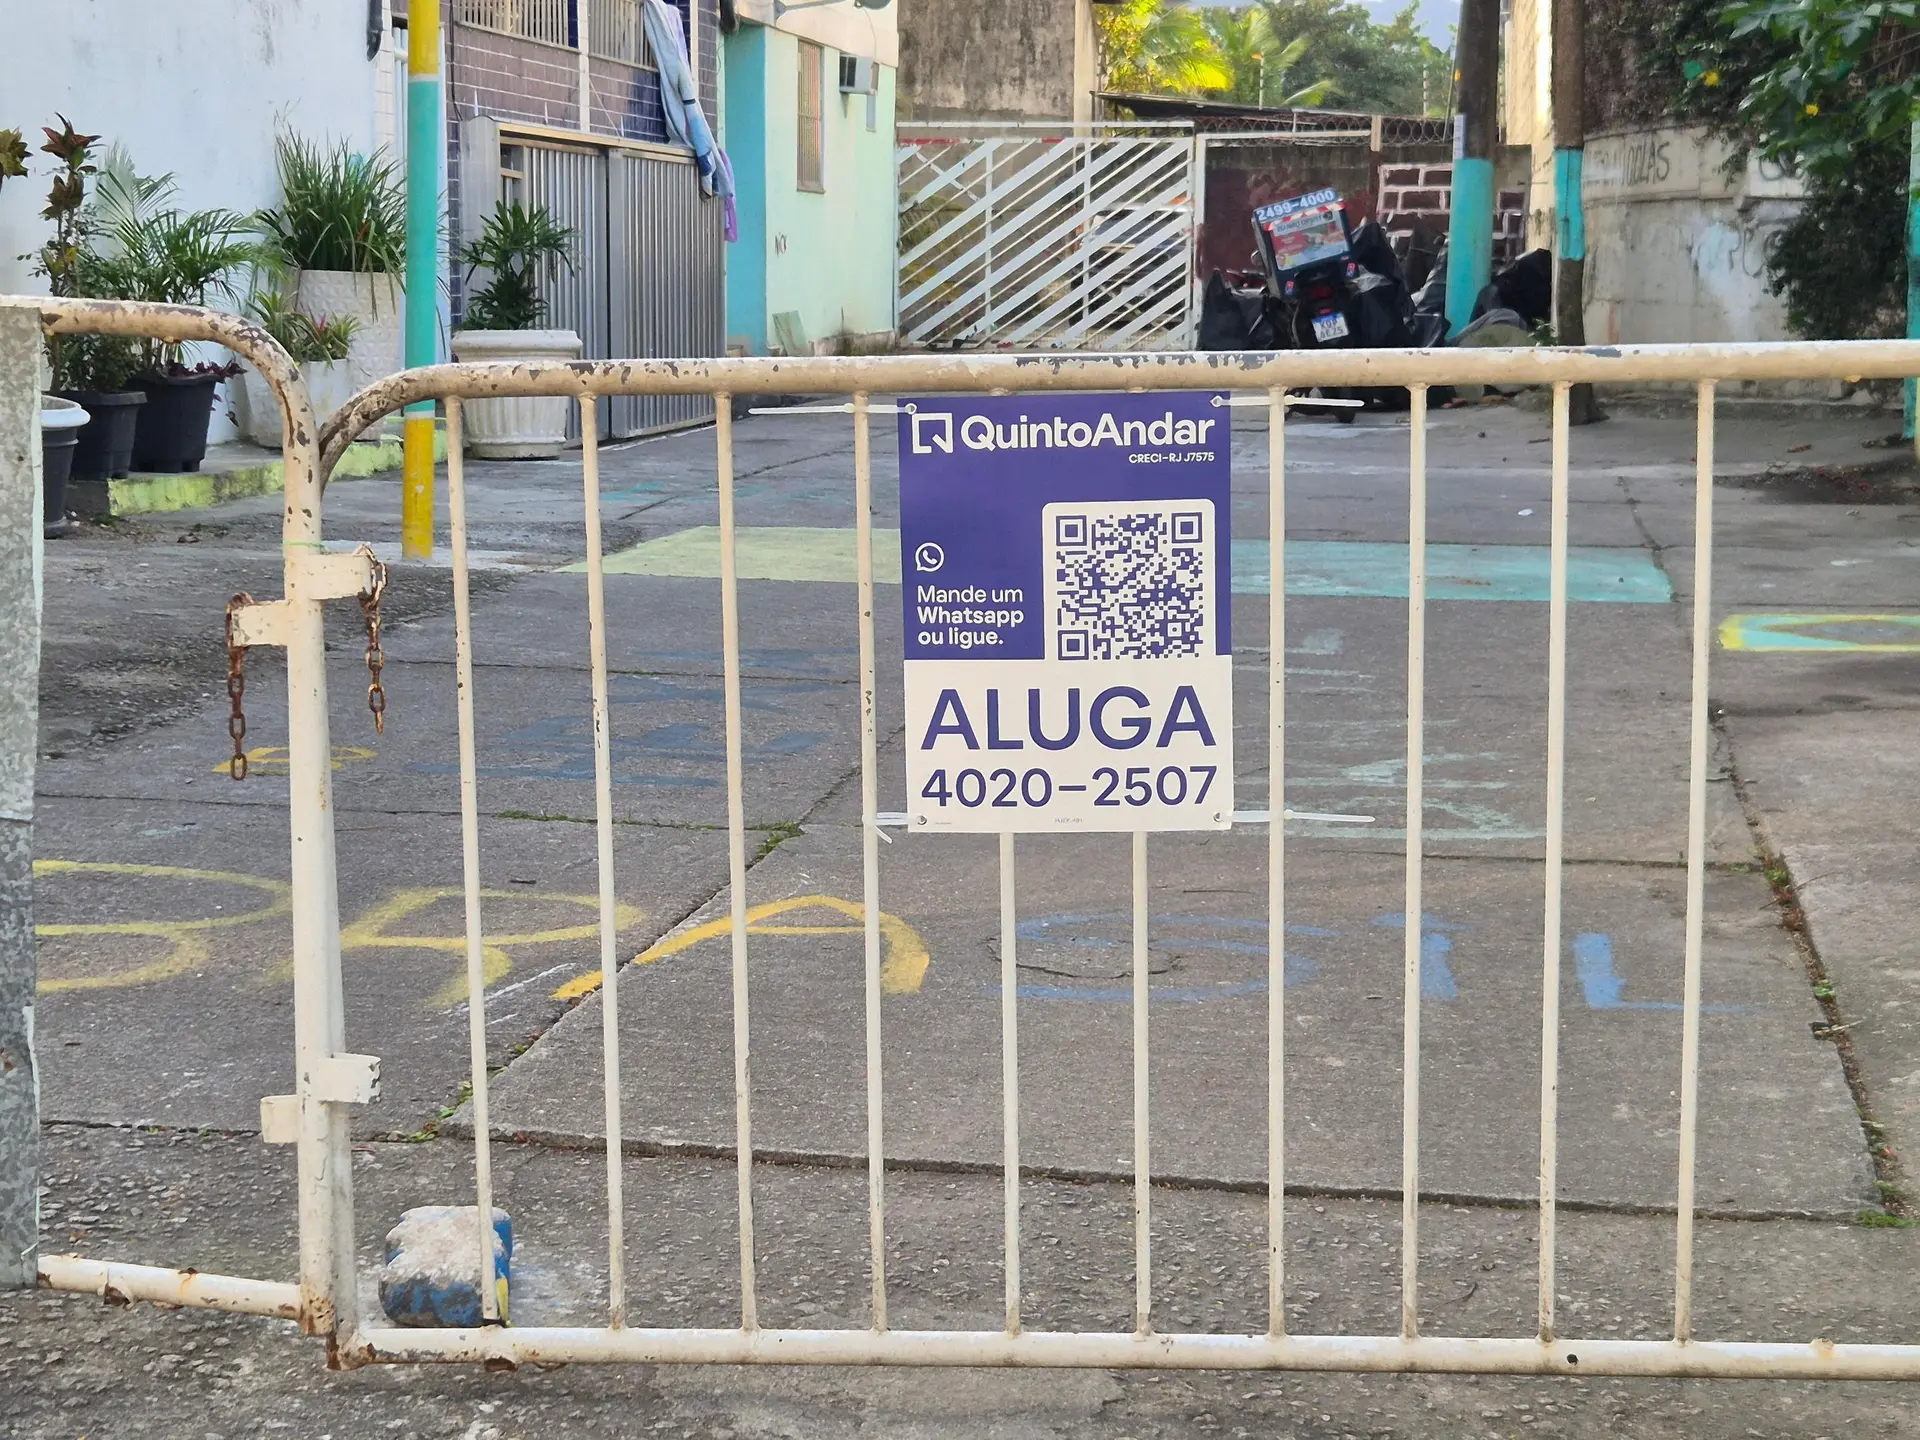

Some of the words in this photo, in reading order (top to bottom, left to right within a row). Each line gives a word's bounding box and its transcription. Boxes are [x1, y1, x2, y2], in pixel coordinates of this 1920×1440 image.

[1255, 189, 1336, 221] 2499-4000
[960, 411, 1216, 452] QuintoAndar
[1128, 453, 1182, 464] CRECI-RJ
[1183, 451, 1216, 463] J7575
[917, 584, 987, 604] Mande
[990, 588, 1024, 603] um
[917, 606, 1025, 628] Whatsapp
[917, 632, 944, 645] ou
[948, 627, 1004, 650] ligue.
[920, 684, 1217, 751] ALUGA
[921, 765, 1218, 808] 4020-2507
